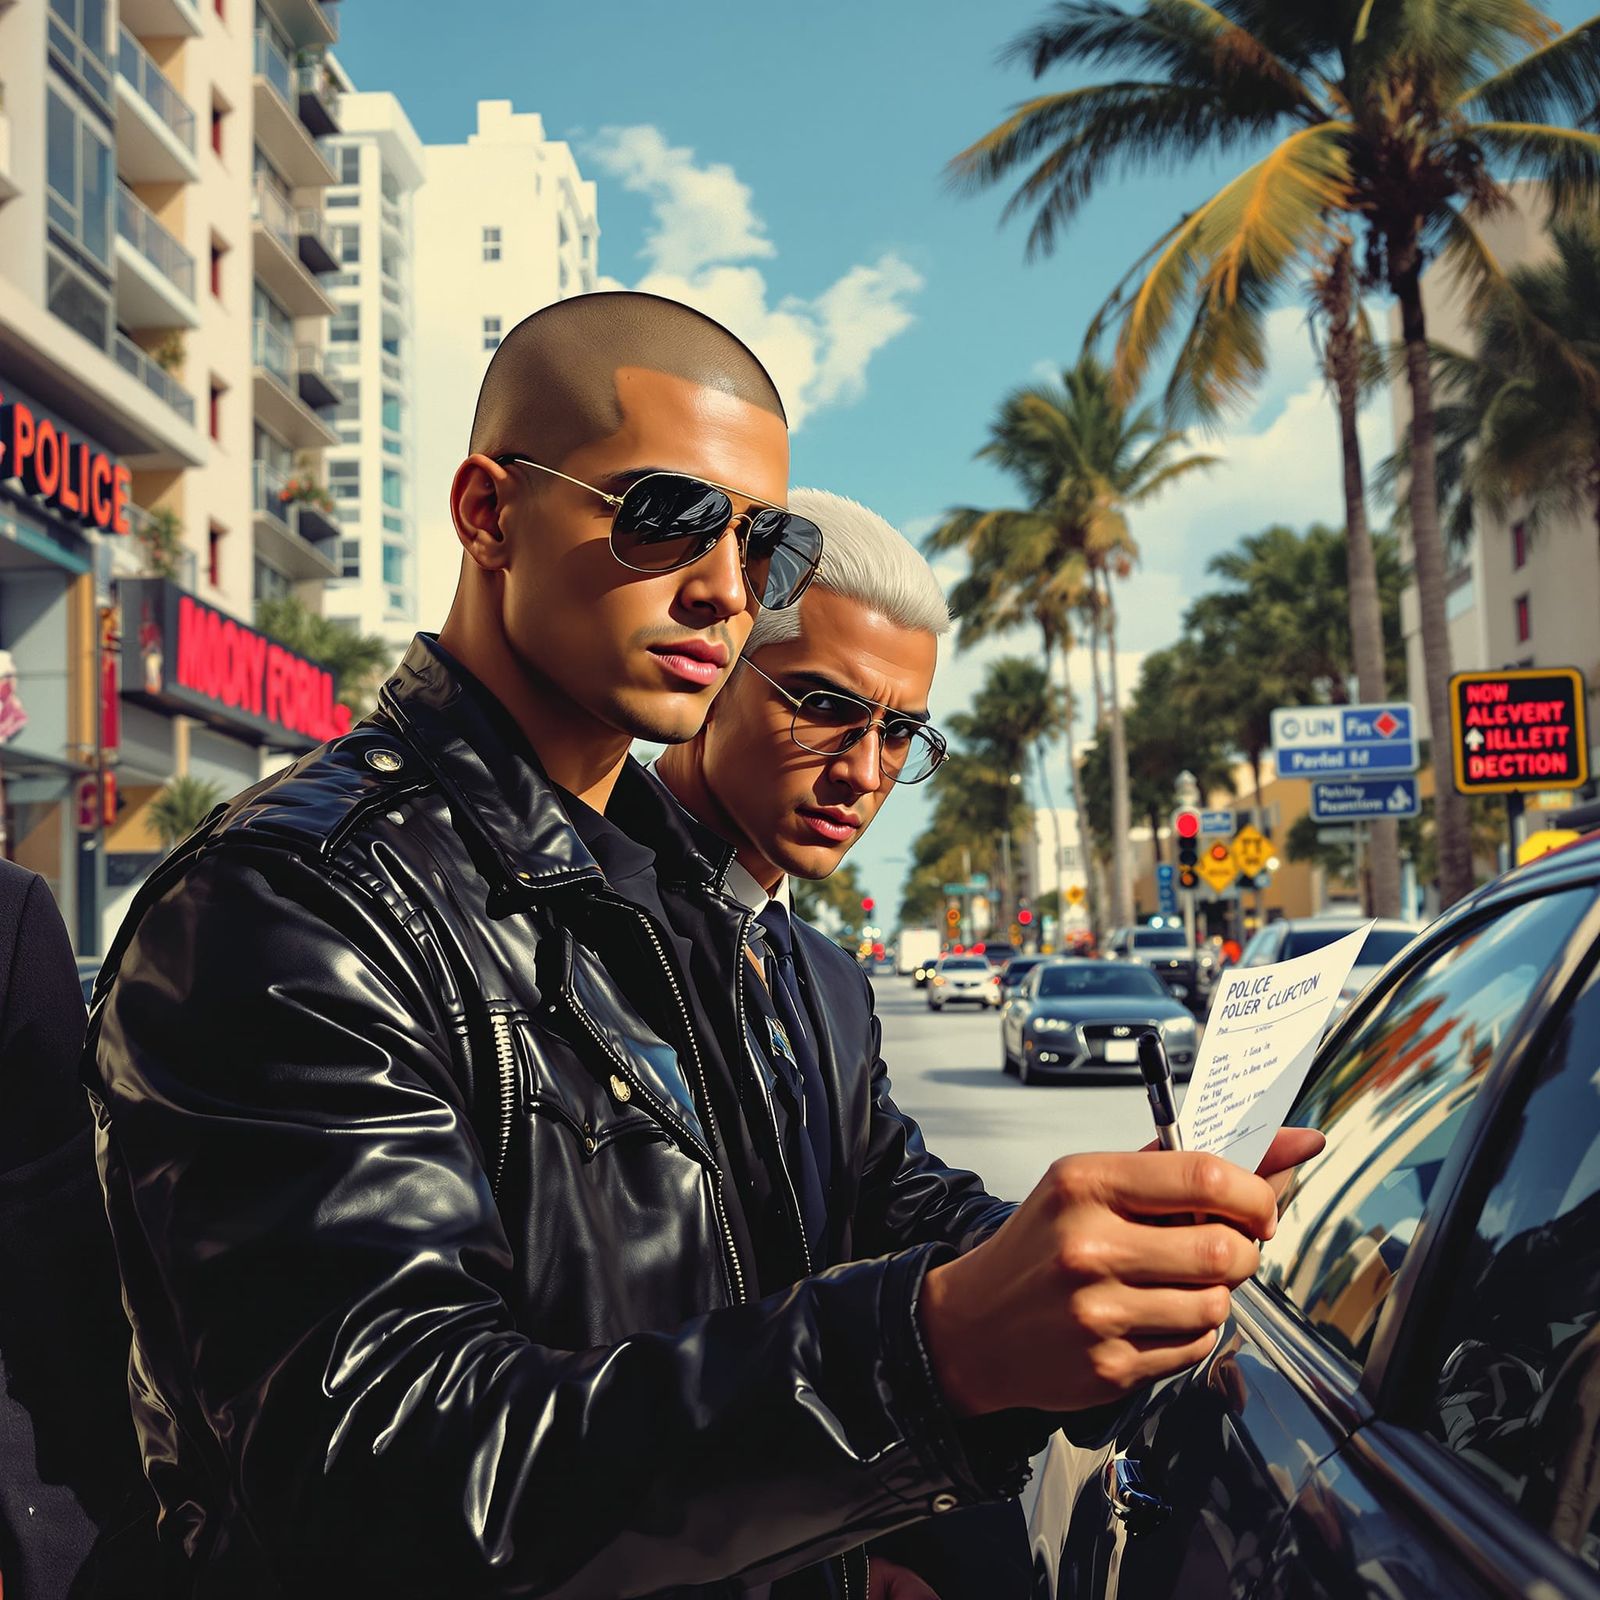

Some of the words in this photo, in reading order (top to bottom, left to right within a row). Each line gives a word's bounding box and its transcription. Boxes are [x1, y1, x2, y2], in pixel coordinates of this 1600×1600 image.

[13, 401, 131, 535] POLICE
[1466, 683, 1509, 703] NOW
[1468, 751, 1568, 779] DECTION
[1226, 975, 1274, 1001] POLICE
